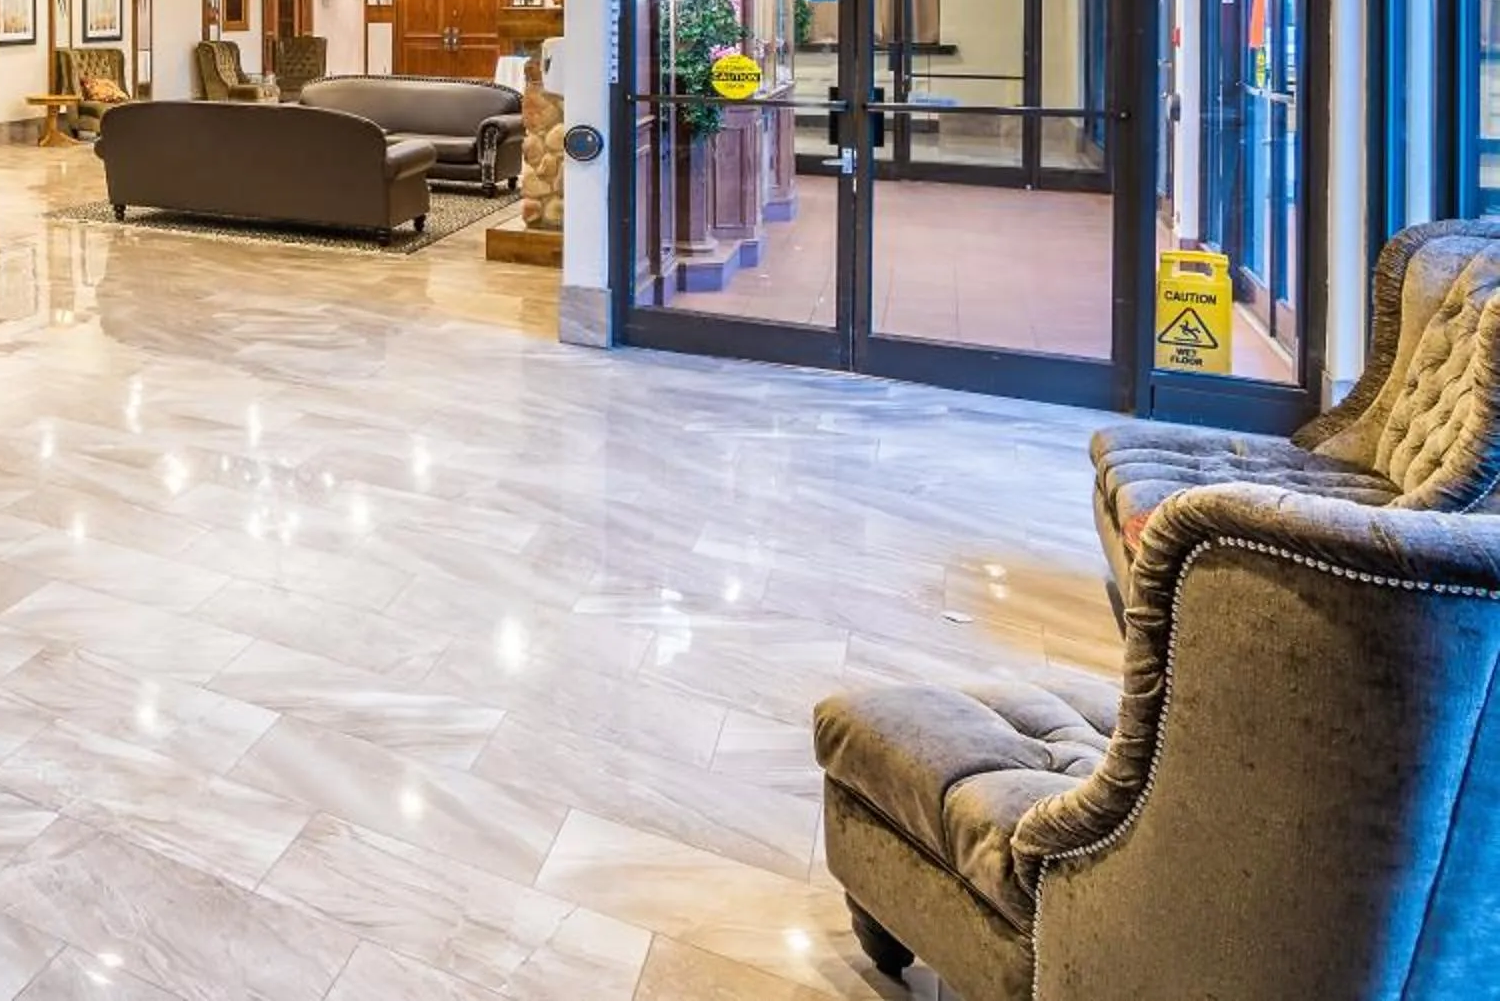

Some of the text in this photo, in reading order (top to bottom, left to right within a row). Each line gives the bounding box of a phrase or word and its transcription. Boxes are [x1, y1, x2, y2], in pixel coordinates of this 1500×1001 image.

[712, 72, 761, 81] CAUTION
[1164, 291, 1217, 305] CAUTION
[1177, 348, 1197, 356] WET
[1170, 355, 1203, 366] FLOOR
